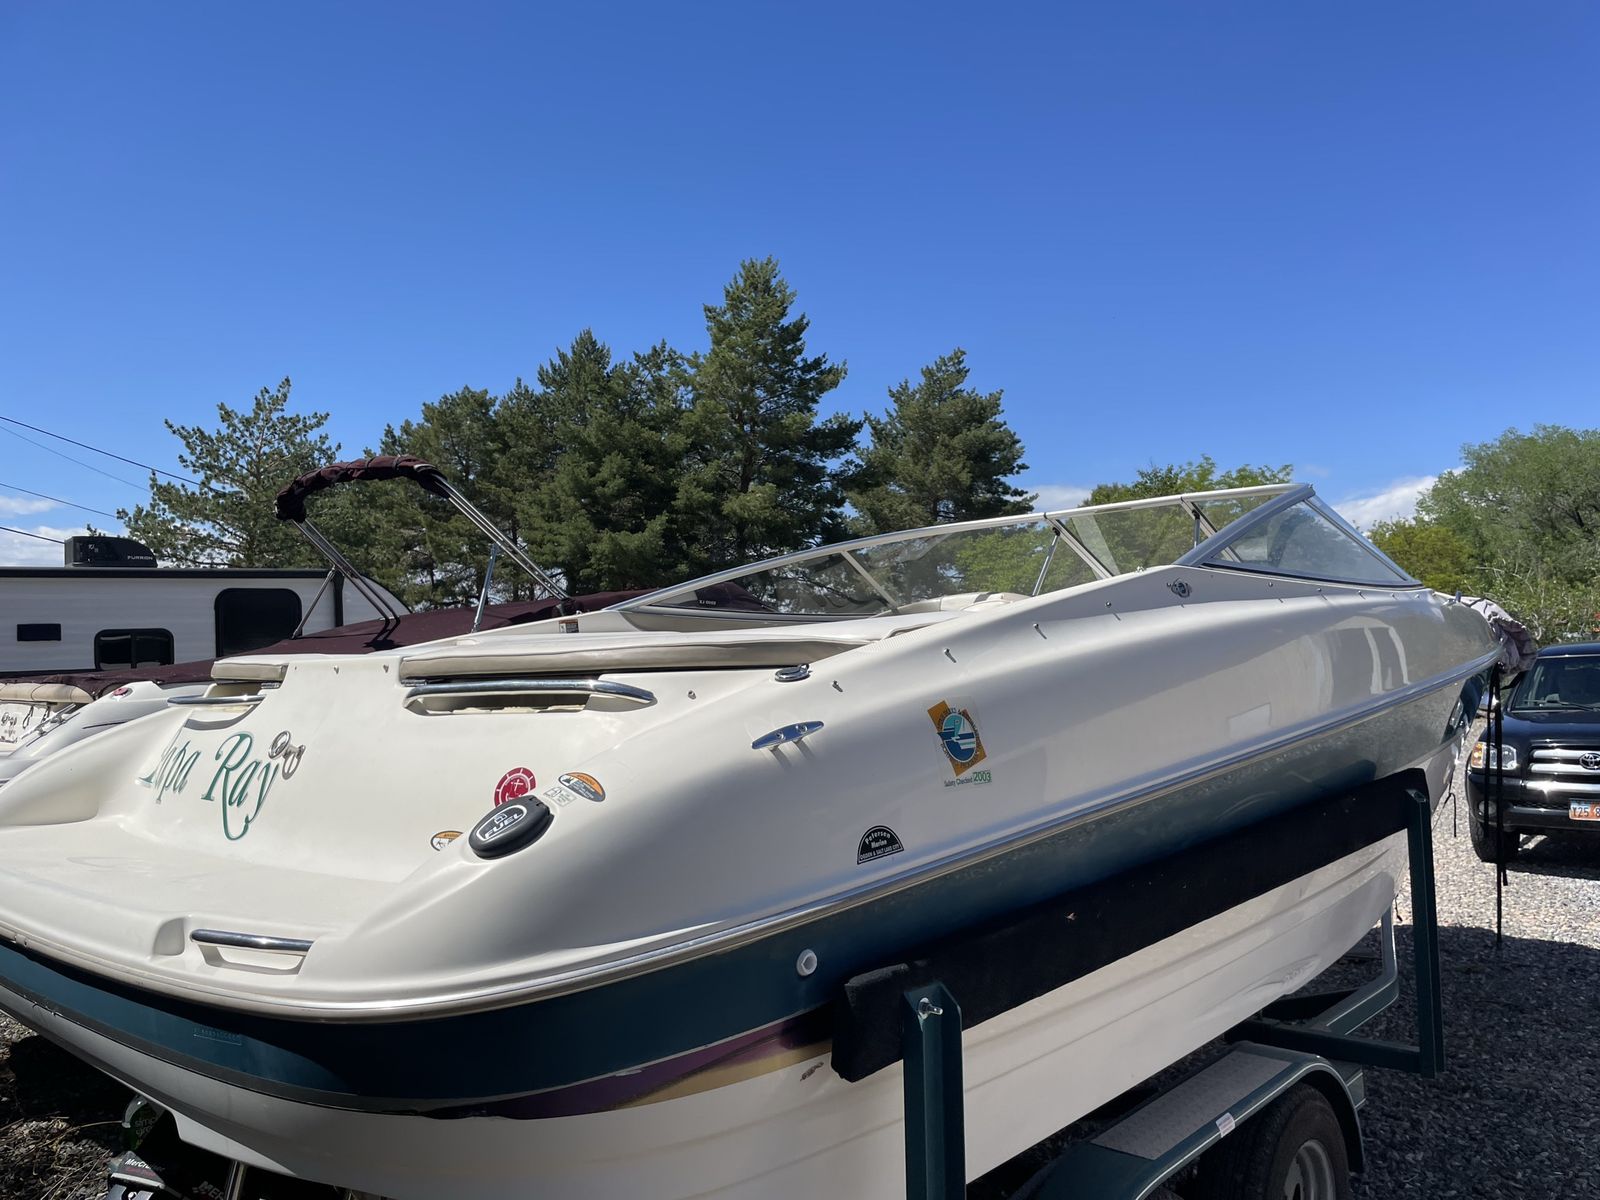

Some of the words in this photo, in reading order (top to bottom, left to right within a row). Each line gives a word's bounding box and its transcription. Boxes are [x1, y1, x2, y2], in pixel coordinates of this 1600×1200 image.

[200, 731, 280, 841] Ray
[973, 770, 992, 783] 2003
[484, 813, 523, 839] FUEL
